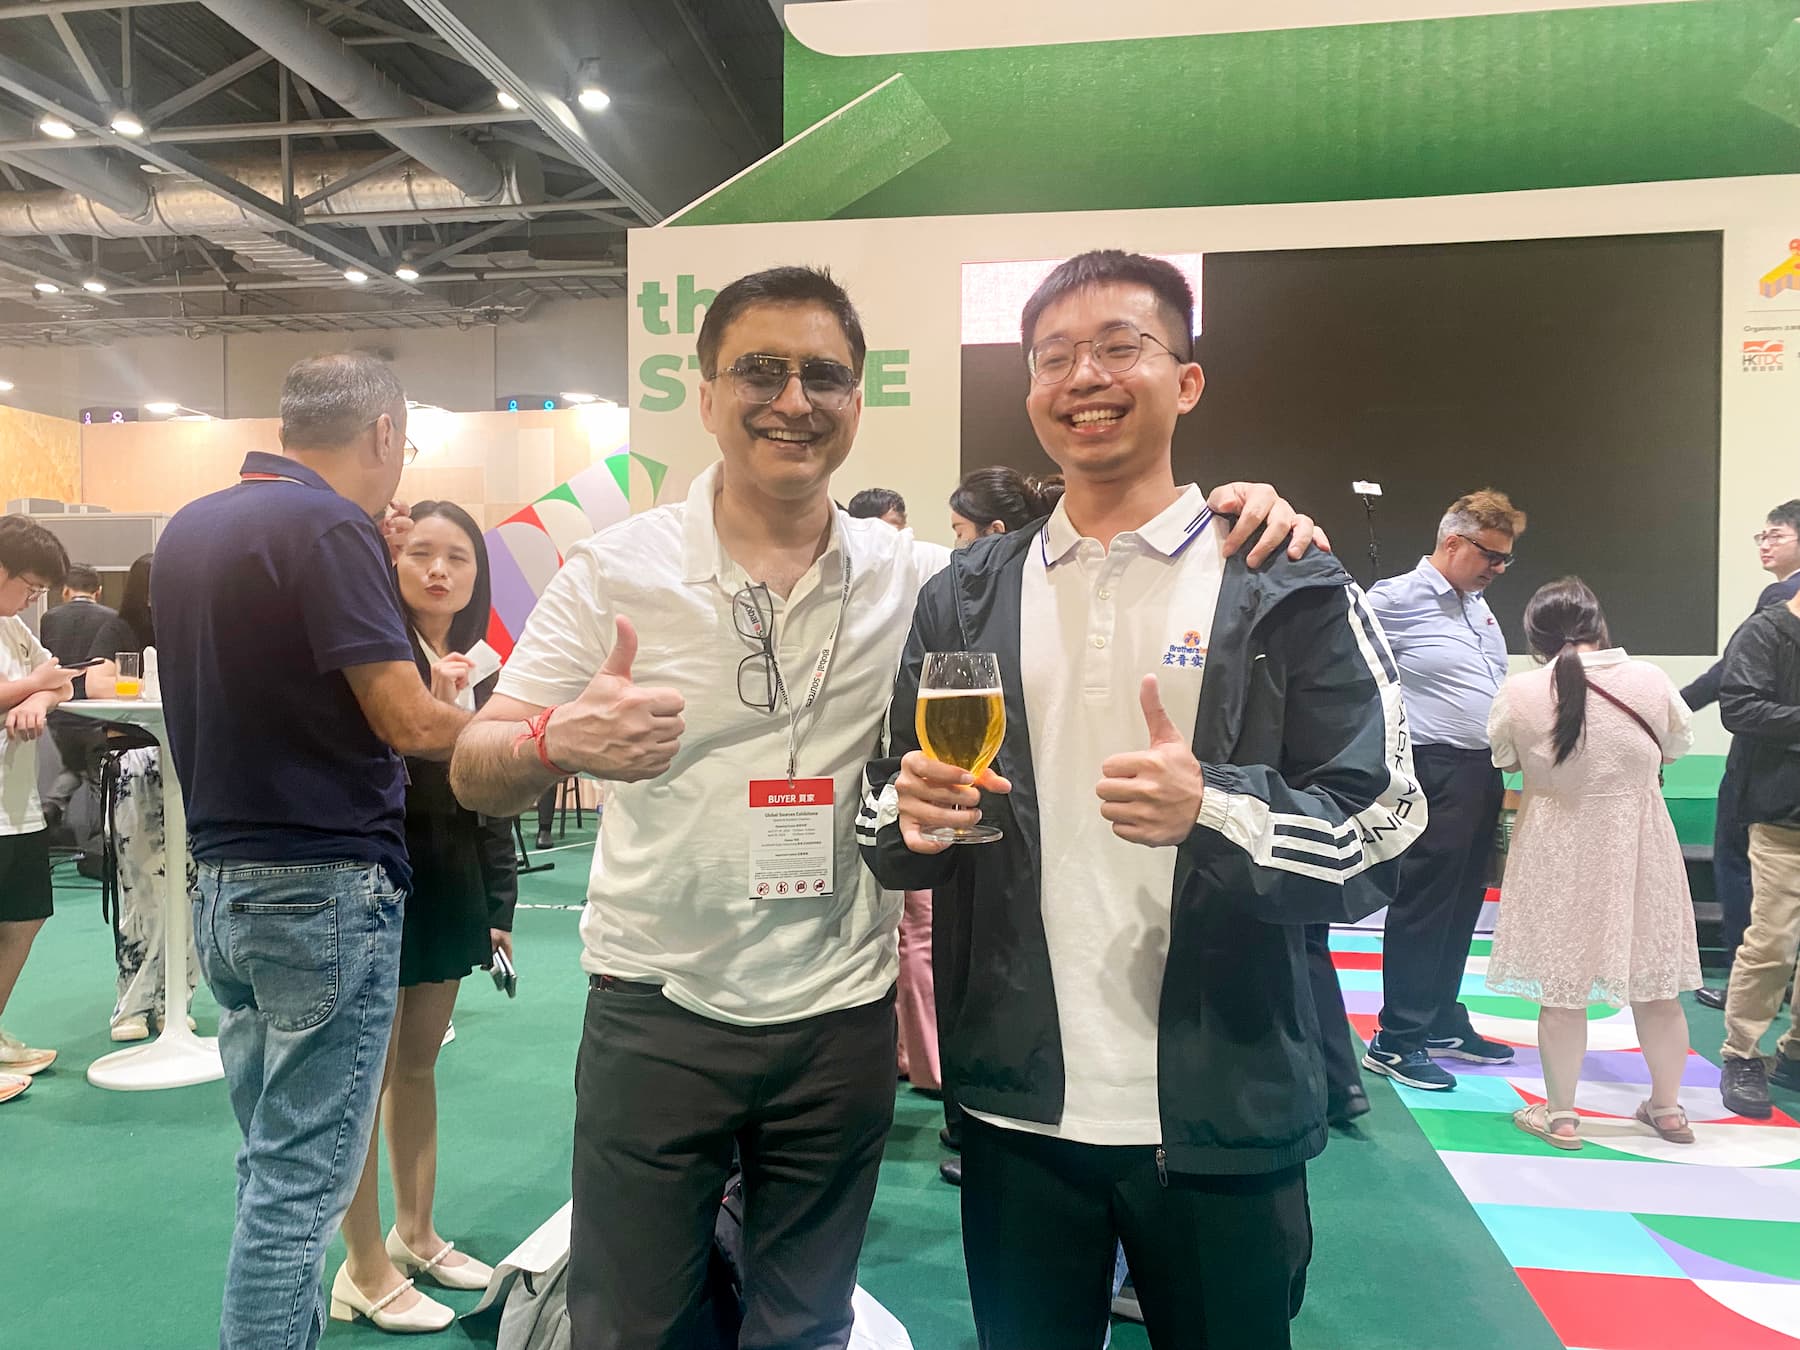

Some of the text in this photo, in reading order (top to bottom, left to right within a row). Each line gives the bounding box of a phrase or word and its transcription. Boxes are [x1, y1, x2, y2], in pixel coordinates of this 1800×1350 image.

[637, 274, 718, 335] th
[1743, 354, 1784, 366] HKTDC
[768, 794, 796, 804] BUYER
